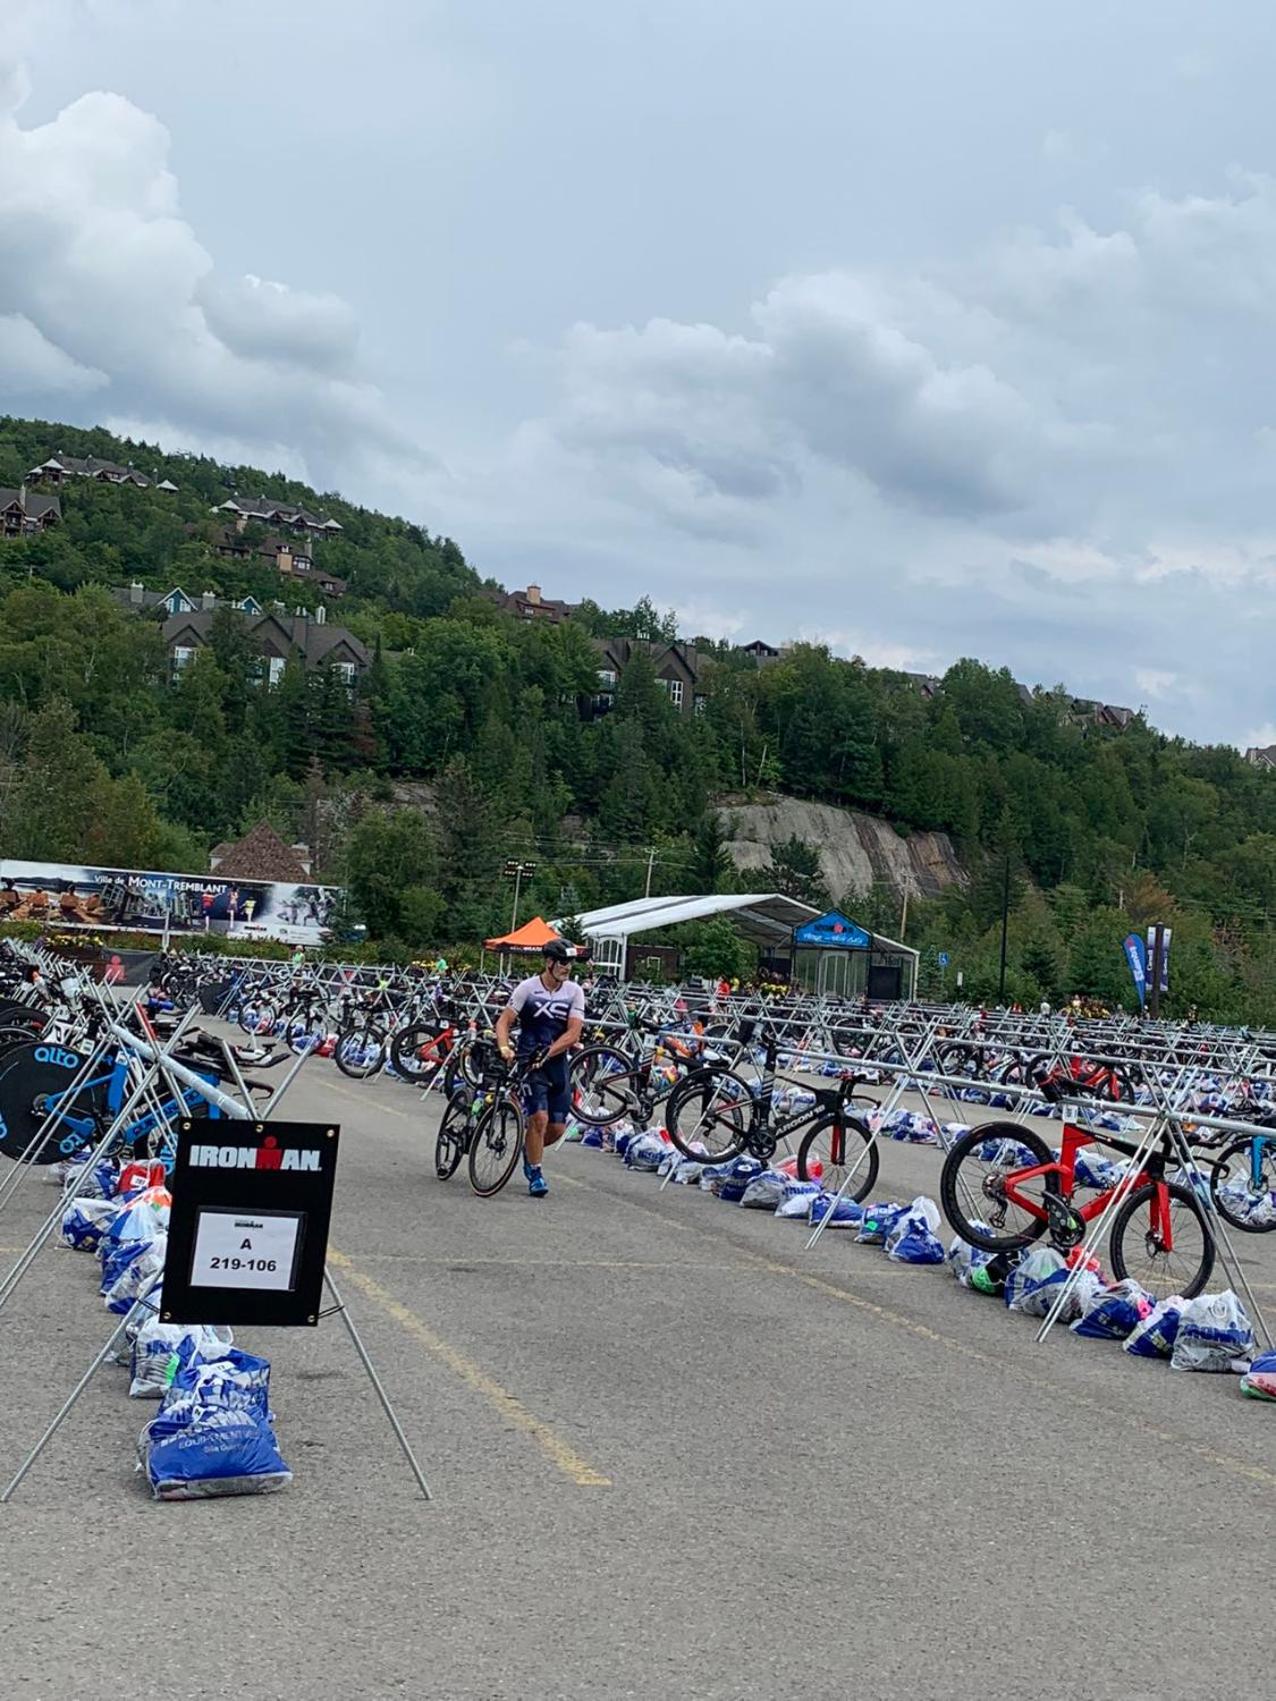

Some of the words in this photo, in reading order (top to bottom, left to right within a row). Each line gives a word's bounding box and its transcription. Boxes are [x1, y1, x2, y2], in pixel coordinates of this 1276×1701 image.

[114, 877, 125, 885] de
[128, 876, 227, 894] MONT-TREMBLANT
[34, 1047, 79, 1069] alto
[775, 1110, 814, 1136] ARGON
[189, 1137, 322, 1171] IRONMAN
[240, 1238, 252, 1250] A
[210, 1257, 277, 1272] 219-106
